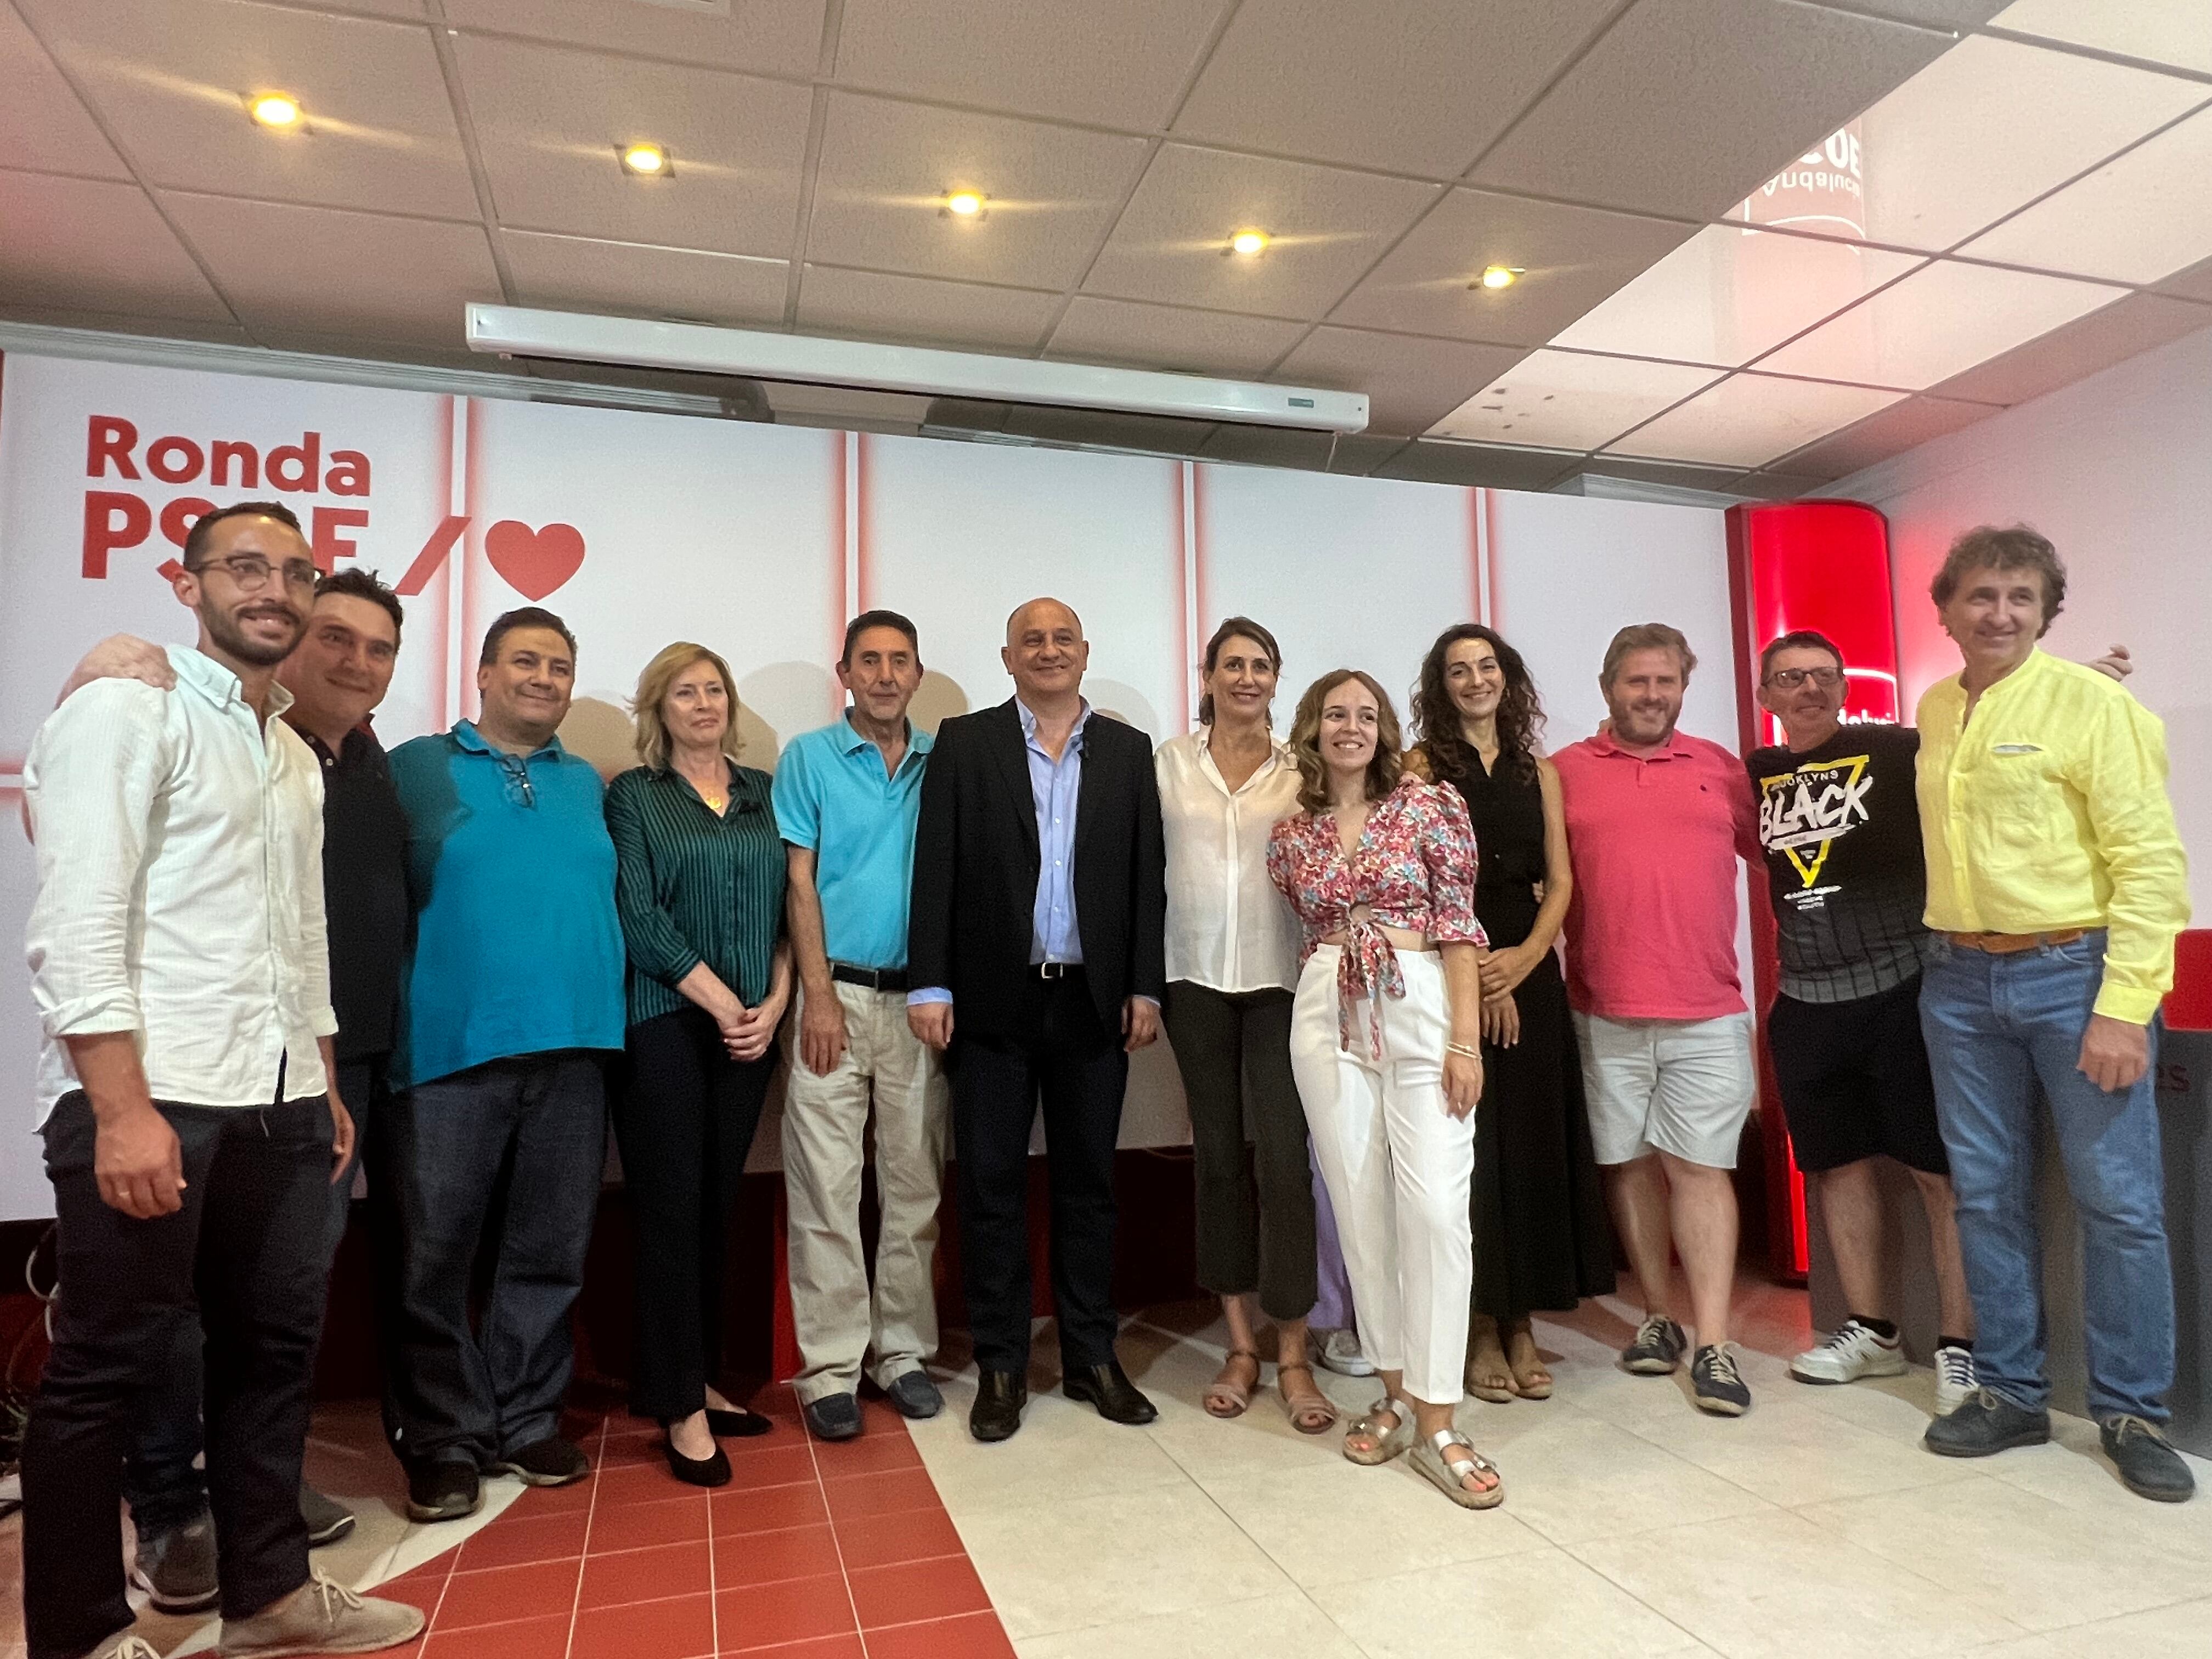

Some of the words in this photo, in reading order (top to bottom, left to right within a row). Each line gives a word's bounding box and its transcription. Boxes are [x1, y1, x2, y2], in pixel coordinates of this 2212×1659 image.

[87, 414, 371, 497] Ronda
[81, 490, 370, 583] PSE
[1759, 775, 1873, 845] BLACK
